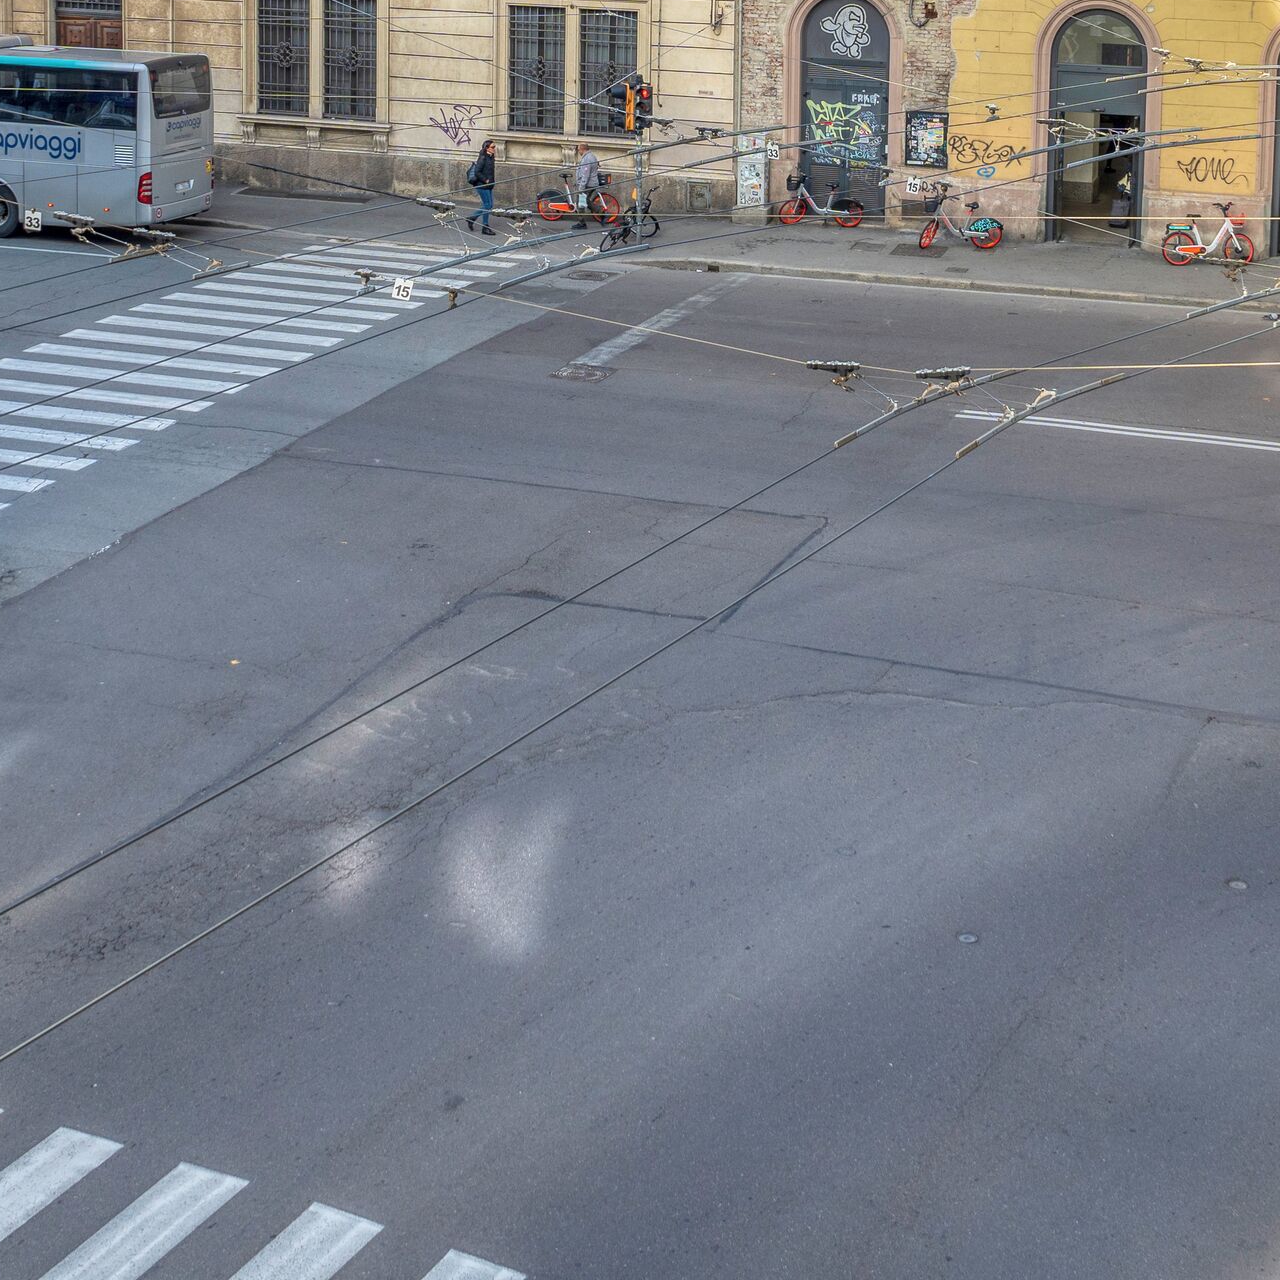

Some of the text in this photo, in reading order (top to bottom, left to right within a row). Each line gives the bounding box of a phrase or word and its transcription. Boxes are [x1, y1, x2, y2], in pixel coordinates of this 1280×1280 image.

[768, 148, 779, 158] 33
[907, 182, 918, 193] 15
[26, 216, 40, 228] 33
[394, 284, 410, 298] 15
